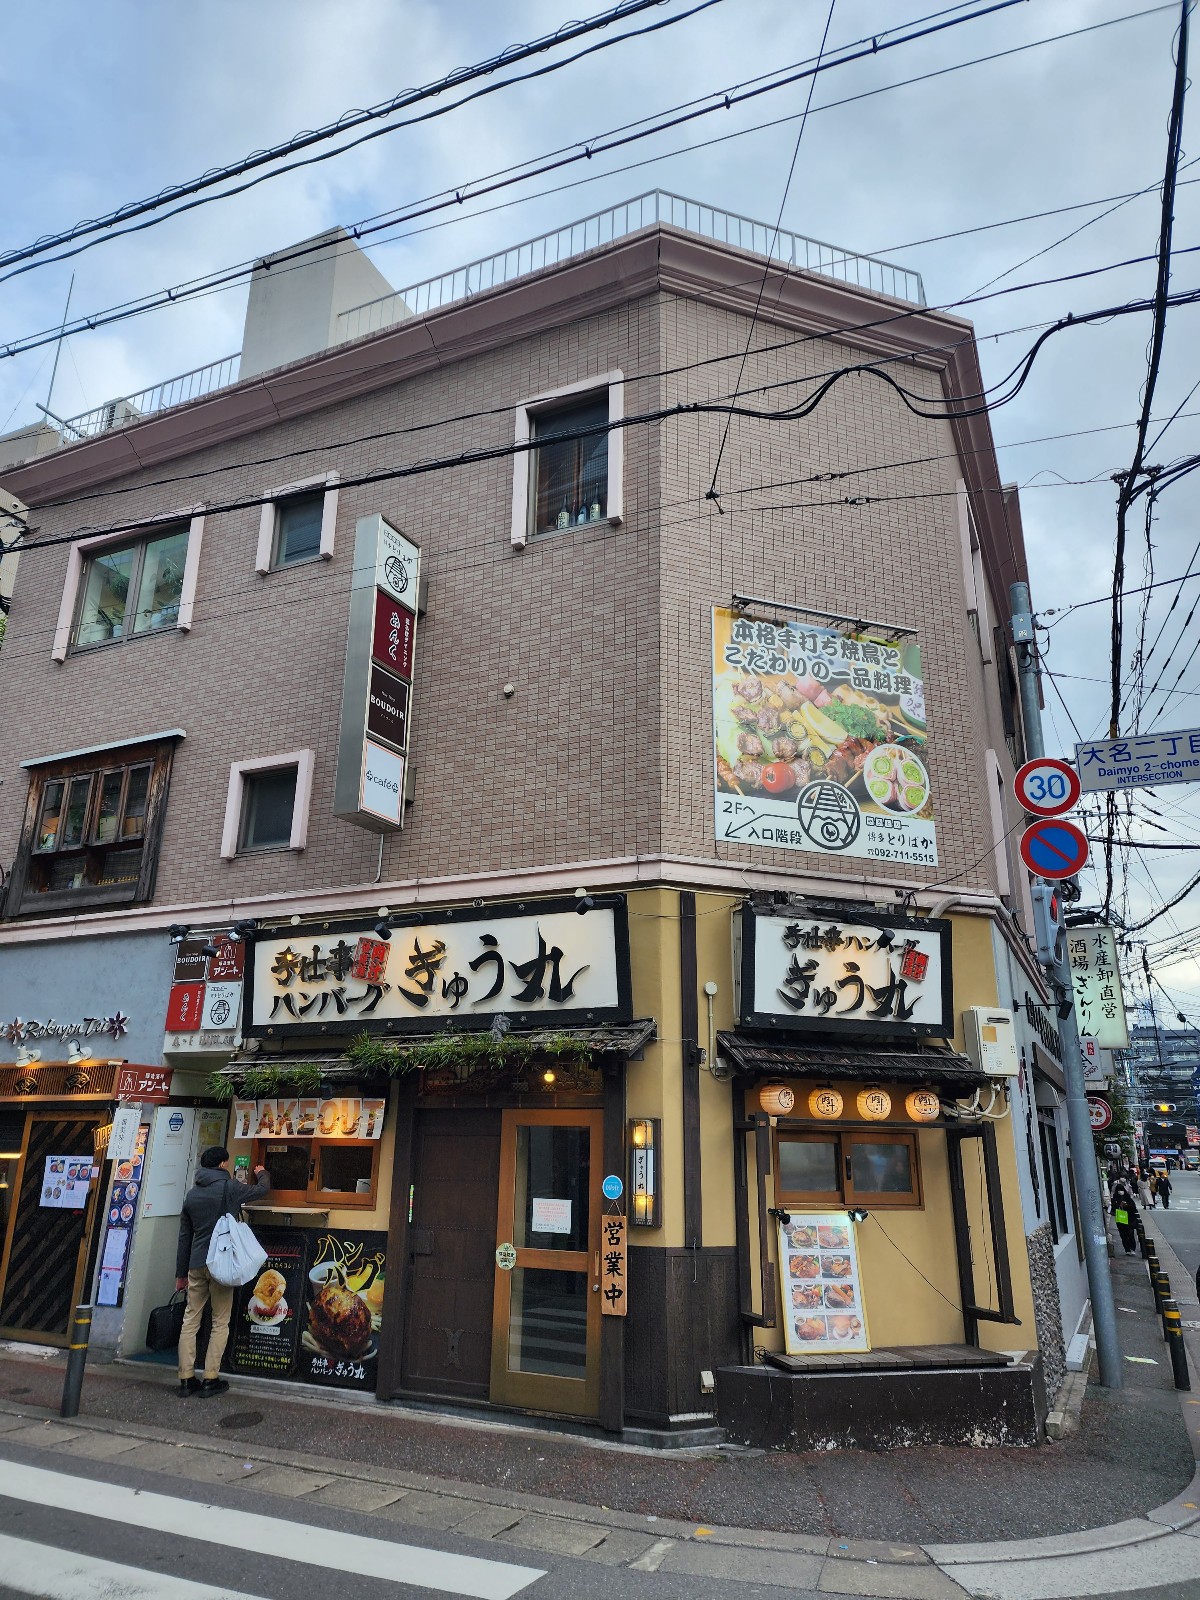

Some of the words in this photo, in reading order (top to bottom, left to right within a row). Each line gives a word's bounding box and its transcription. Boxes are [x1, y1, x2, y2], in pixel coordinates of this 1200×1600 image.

[734, 619, 900, 668] 本格手打ち焼鳥と
[725, 646, 913, 696] こだわりの一品料理
[370, 694, 405, 721] BOUDOIR
[373, 774, 392, 790] café
[1098, 765, 1140, 778] Daimyo
[1144, 759, 1200, 773] 2-chome
[1117, 771, 1183, 785] INTERSECTION
[1029, 774, 1066, 801] 30
[723, 801, 755, 815] 2Fへ
[748, 827, 803, 844] 入口階段
[176, 955, 206, 965] BOUDOIR
[271, 939, 355, 986] 手仕事
[397, 921, 591, 1009] ぎゅう丸
[1070, 939, 1089, 971] 酒場
[213, 966, 239, 977] アジート
[776, 953, 924, 1020] ぎゅう丸
[1092, 933, 1118, 1020] 水産卸直営
[269, 983, 391, 1019] ハンバーグ
[1075, 974, 1101, 1037] ぎんりん
[138, 1079, 170, 1092] アジート
[236, 1099, 384, 1137] TAKEOUT
[637, 1155, 645, 1192] ぎゅう丸
[603, 1221, 624, 1308] 営業中
[335, 1361, 366, 1380] ぎゅう丸
